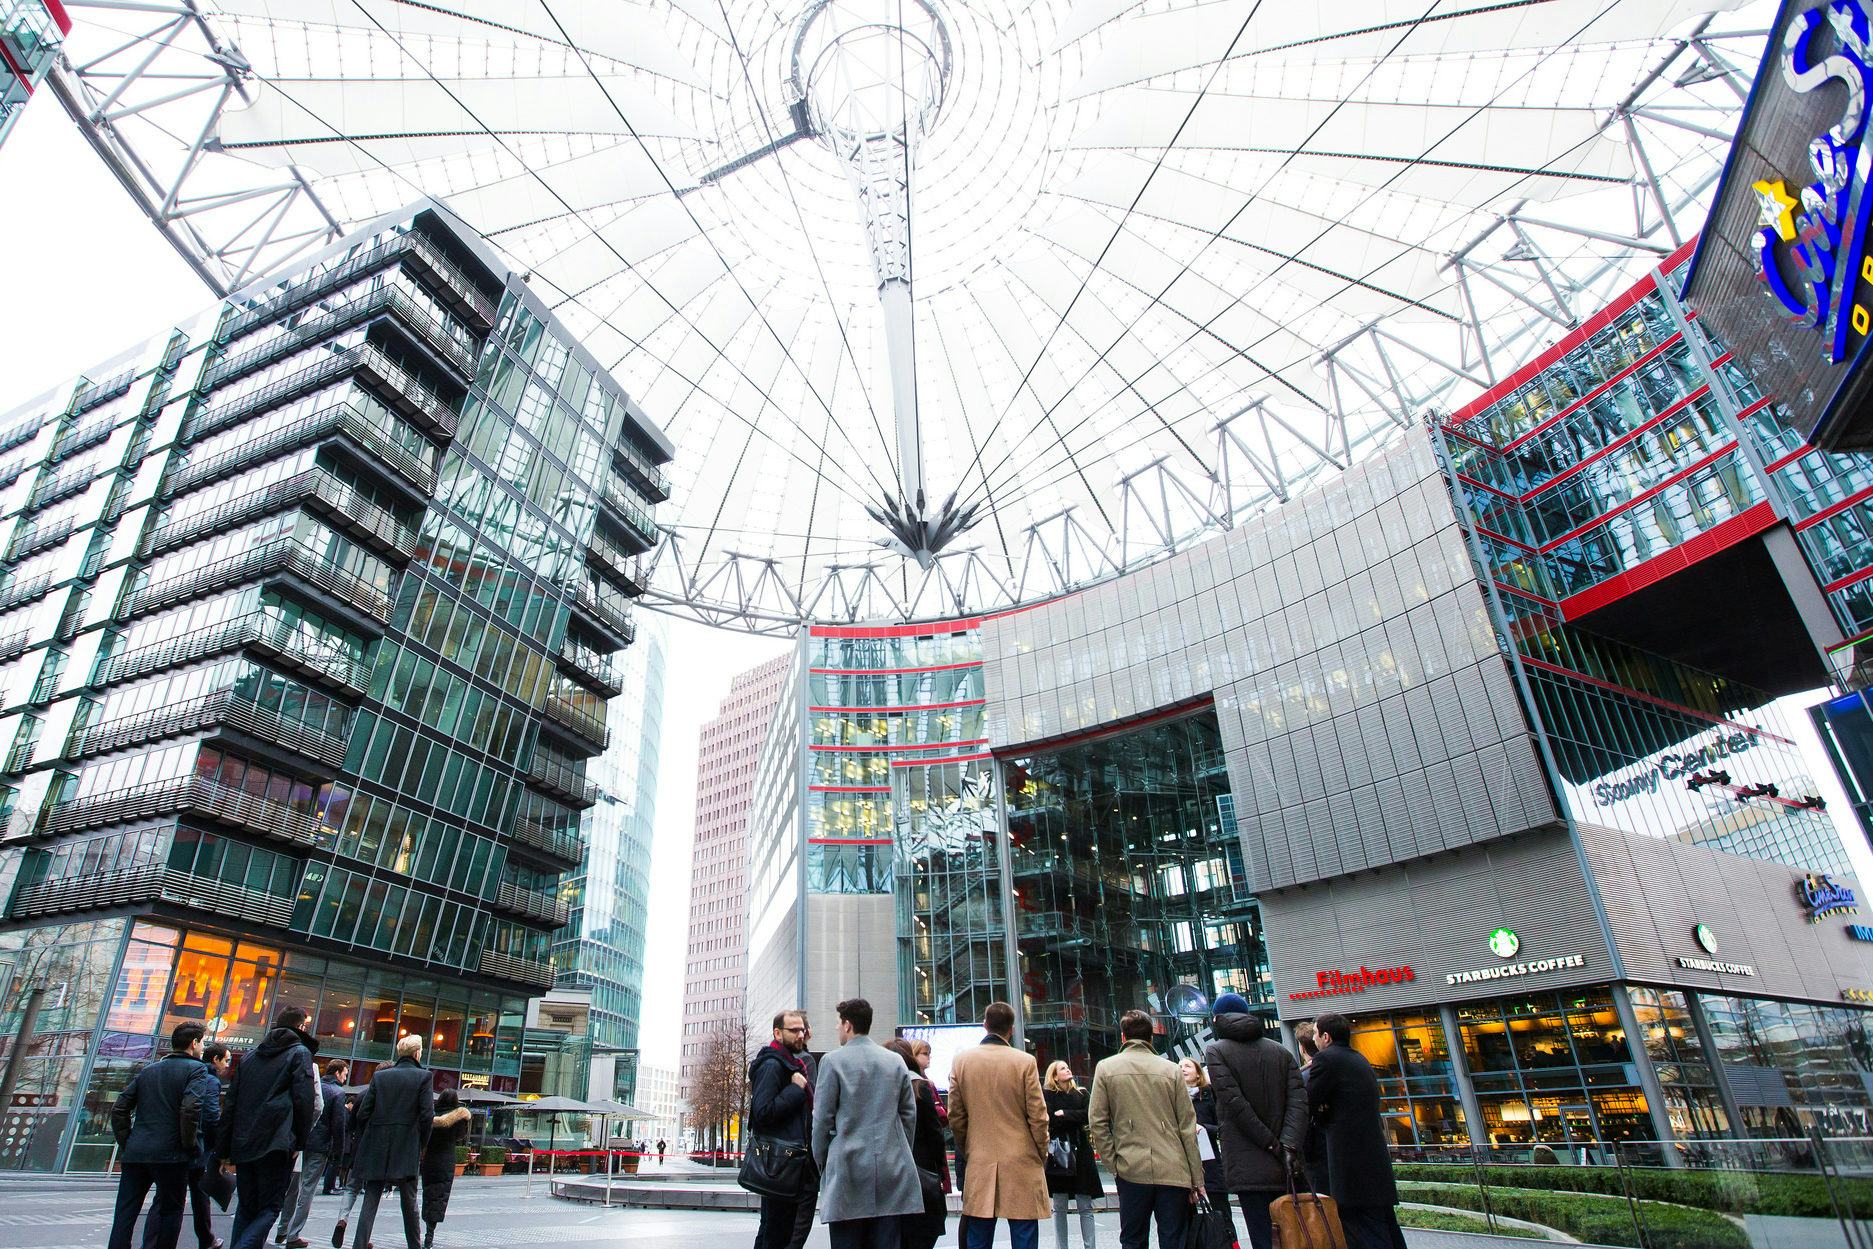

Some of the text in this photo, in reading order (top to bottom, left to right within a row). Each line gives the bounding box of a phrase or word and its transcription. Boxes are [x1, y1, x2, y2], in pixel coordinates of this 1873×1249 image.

[1660, 724, 1763, 781] Center
[1852, 924, 1873, 942] IM
[1316, 964, 1416, 989] Filmhaus
[1446, 954, 1585, 986] STARBUCKS COFFEE
[1679, 957, 1755, 977] STARBUCKS COFFEE
